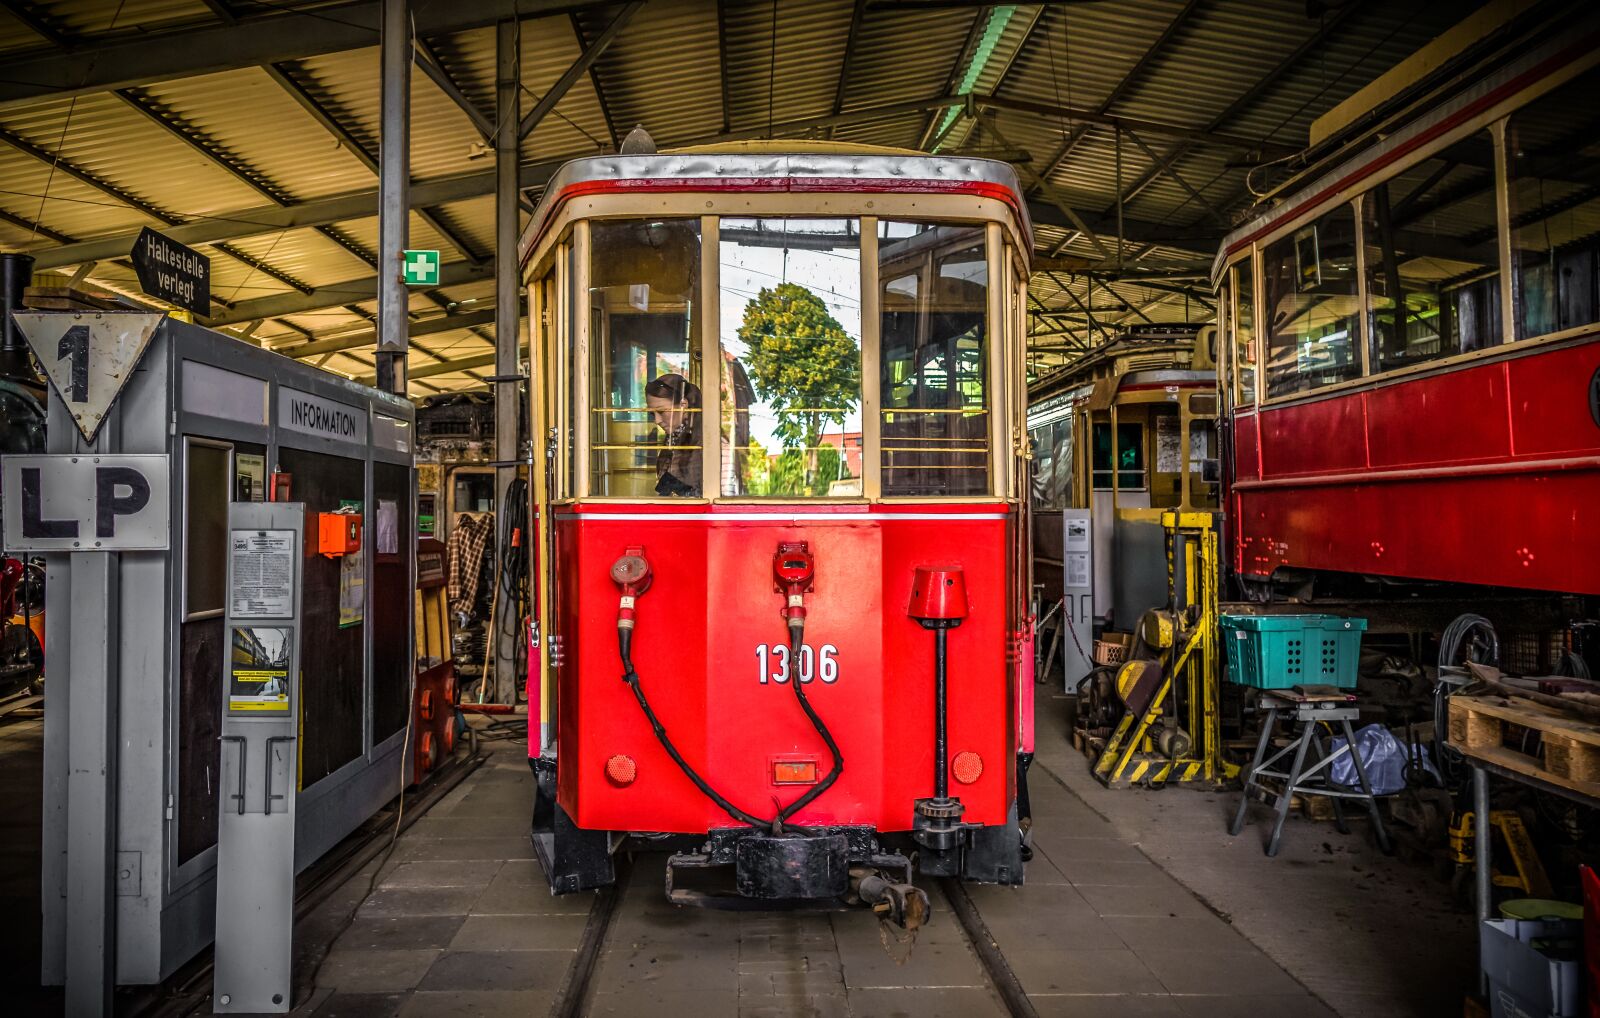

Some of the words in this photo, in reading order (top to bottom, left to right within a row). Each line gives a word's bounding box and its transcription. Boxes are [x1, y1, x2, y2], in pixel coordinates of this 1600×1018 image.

[147, 234, 204, 279] Haltestelle
[158, 271, 194, 304] verlegt
[58, 325, 90, 402] 1
[291, 398, 356, 438] INFORMATION
[756, 644, 839, 685] 1306
